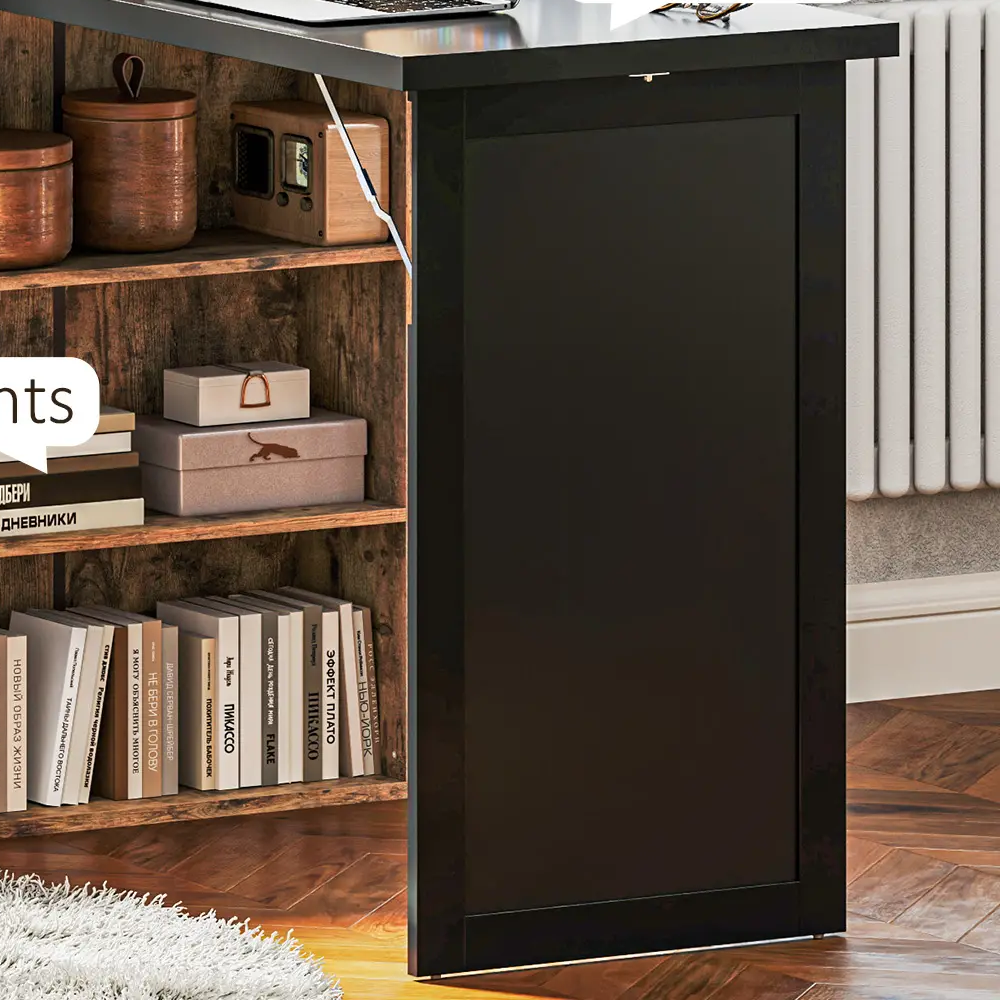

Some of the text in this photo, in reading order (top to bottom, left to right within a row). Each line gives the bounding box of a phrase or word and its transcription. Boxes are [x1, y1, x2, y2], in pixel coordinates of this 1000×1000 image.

[1, 512, 77, 532] ДНЕВНИКИ
[148, 673, 158, 686] НЕ
[266, 664, 274, 679] ДЕНЬ
[94, 687, 105, 718] Религия
[148, 689, 158, 717] БЕРИ
[166, 662, 174, 761] ДАВИД СЕРВАН-ШРЕЙБЕР
[326, 650, 335, 744] ЭФФЕКТ ПЛАТО
[13, 659, 23, 789] НОВЫЙ ОБРАЗ ЖИЗНИ
[90, 719, 100, 746] черной
[224, 704, 234, 754] ПИКАССО
[307, 692, 319, 760] ПИКАССО
[358, 682, 372, 757] НЬЮ-ЙОРК
[58, 722, 69, 759] ДАЛЬНЕГО
[148, 730, 158, 772] ГОЛОВУ
[266, 734, 275, 764] FLAKE
[53, 760, 63, 792] ВОСТОКА
[84, 748, 96, 788] водолазки
